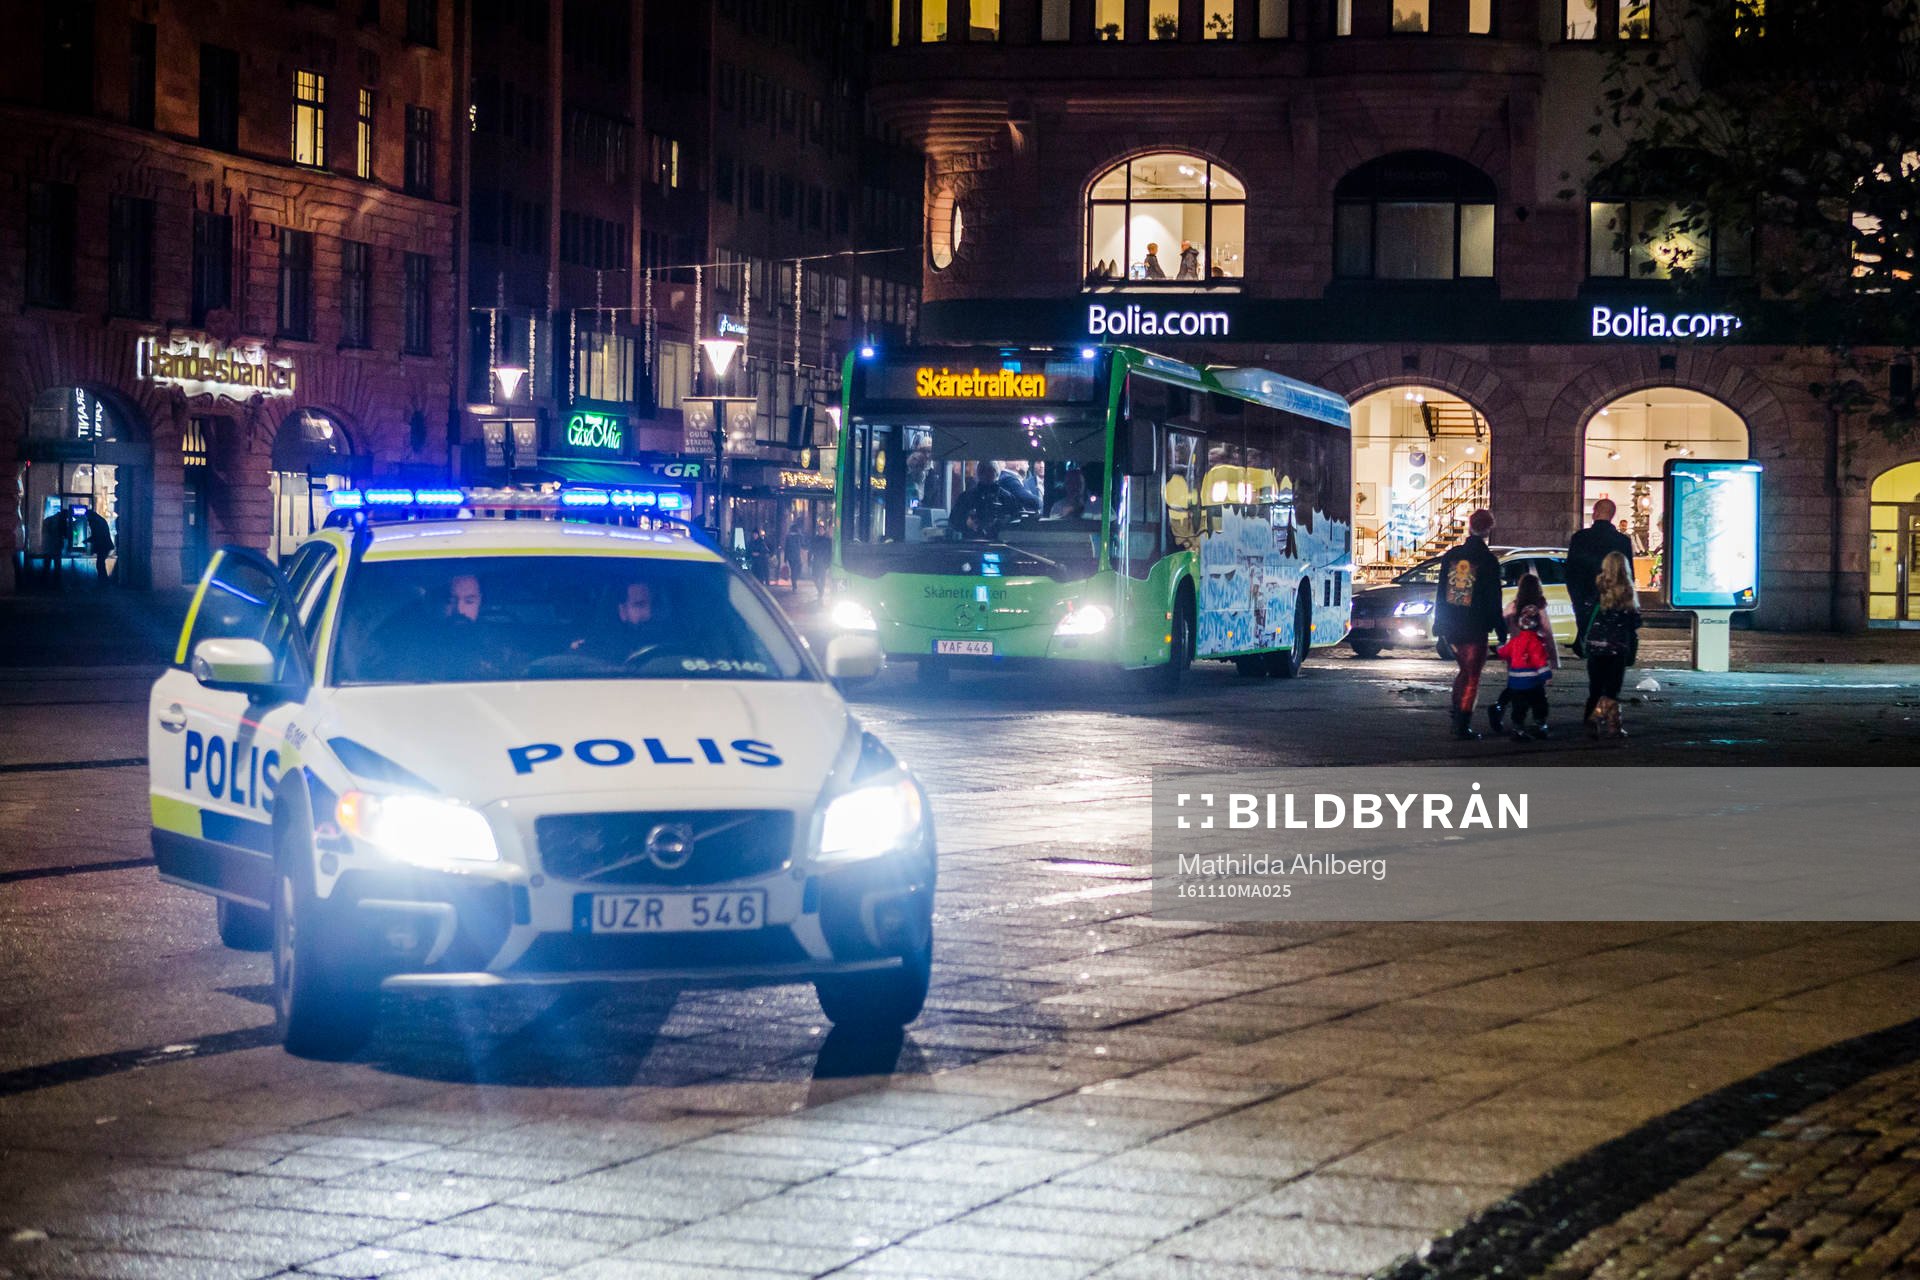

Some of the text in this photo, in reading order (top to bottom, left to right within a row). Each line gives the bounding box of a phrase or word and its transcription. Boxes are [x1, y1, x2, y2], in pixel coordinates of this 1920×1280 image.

[1088, 305, 1230, 336] Bolia.com
[137, 336, 296, 391] Handelsbanken
[916, 367, 1047, 399] Skånetrafiken
[650, 463, 701, 478] TGR
[942, 641, 989, 654] YAF 446
[185, 729, 280, 815] POLIS
[507, 738, 784, 776] POLIS
[599, 896, 756, 929] UZR 546
